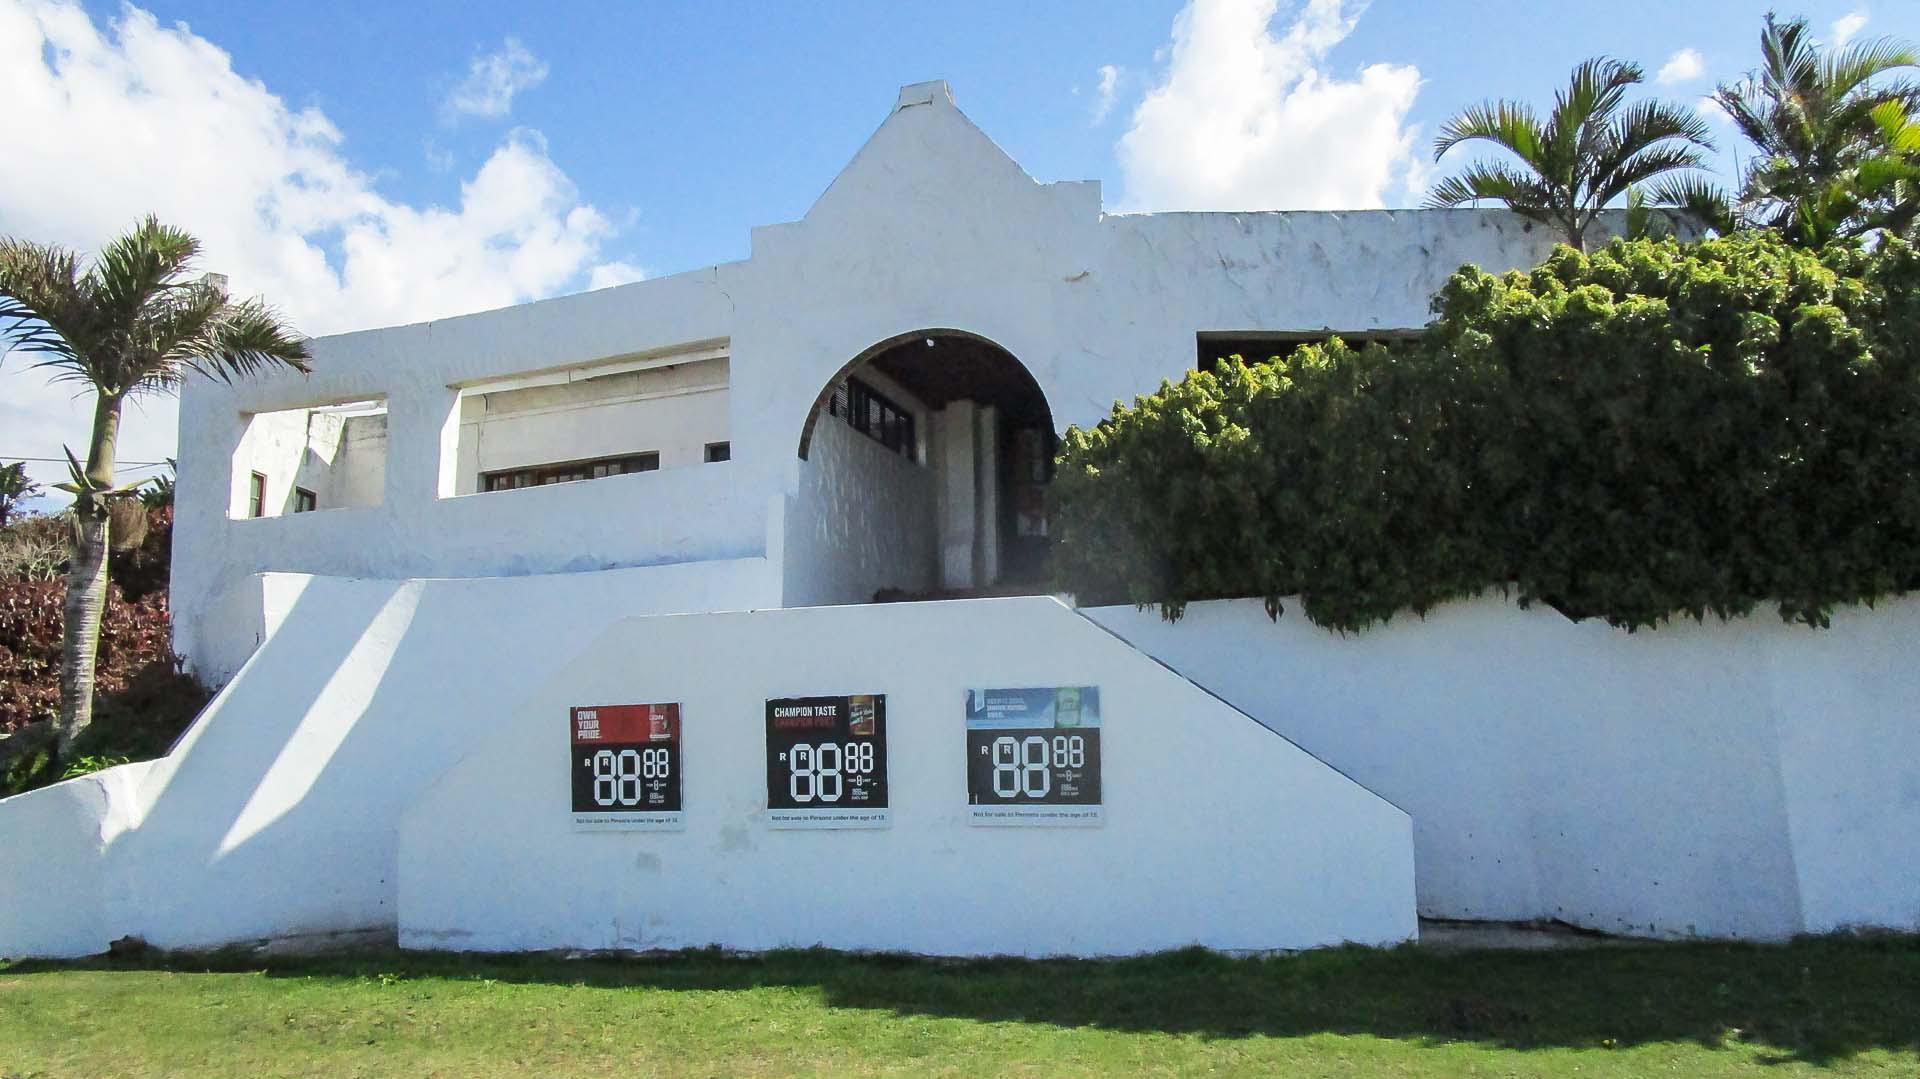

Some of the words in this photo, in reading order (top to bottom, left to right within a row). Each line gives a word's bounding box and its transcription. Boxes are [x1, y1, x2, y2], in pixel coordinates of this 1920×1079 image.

[578, 711, 596, 720] OWN
[774, 706, 812, 718] CHAMPION
[815, 705, 836, 716] TASTE
[578, 721, 599, 729] YOUR
[982, 746, 988, 754] R
[780, 752, 786, 760] R
[584, 758, 591, 767] R
